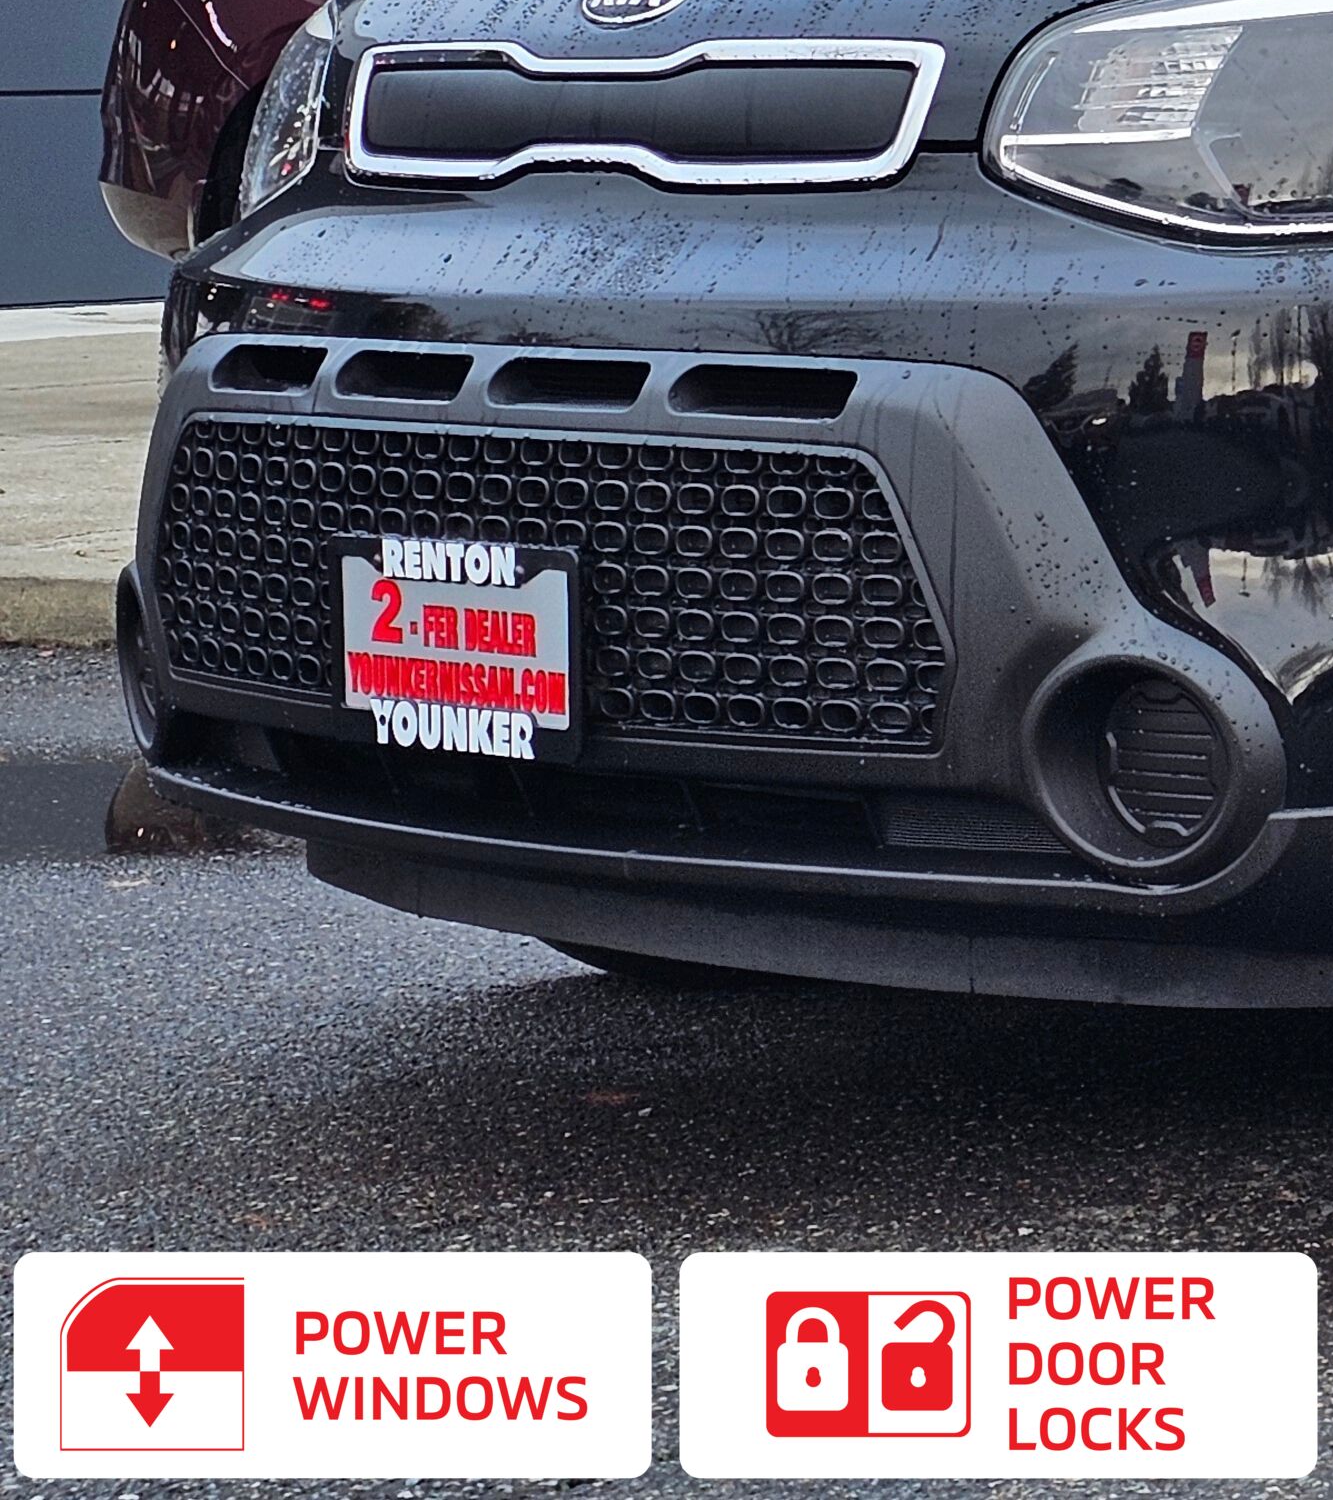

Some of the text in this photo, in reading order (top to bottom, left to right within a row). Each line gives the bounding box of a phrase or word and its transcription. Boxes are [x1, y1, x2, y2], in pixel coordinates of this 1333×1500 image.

[381, 538, 516, 587] RENTON
[464, 608, 537, 658] DEALER
[347, 650, 566, 716] YOUNKERNISSAN.COM
[370, 698, 536, 760] YOUNKER
